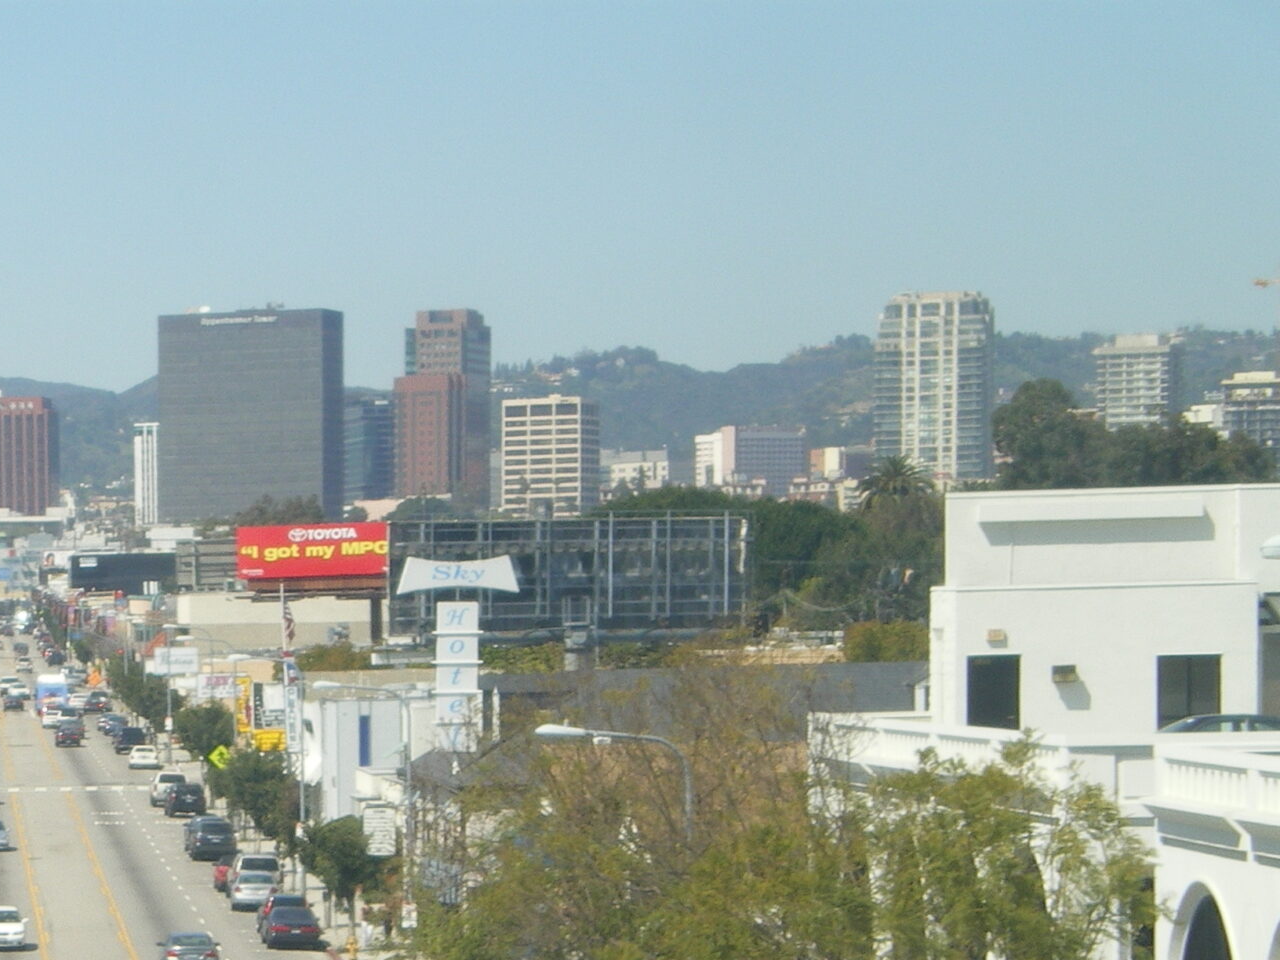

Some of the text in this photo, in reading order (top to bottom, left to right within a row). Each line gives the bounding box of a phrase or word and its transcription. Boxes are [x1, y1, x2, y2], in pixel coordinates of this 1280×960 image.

[307, 527, 357, 540] TOYOTA
[264, 543, 301, 562] got
[305, 544, 336, 560] my
[341, 540, 389, 556] MPG
[431, 564, 485, 583] Sky
